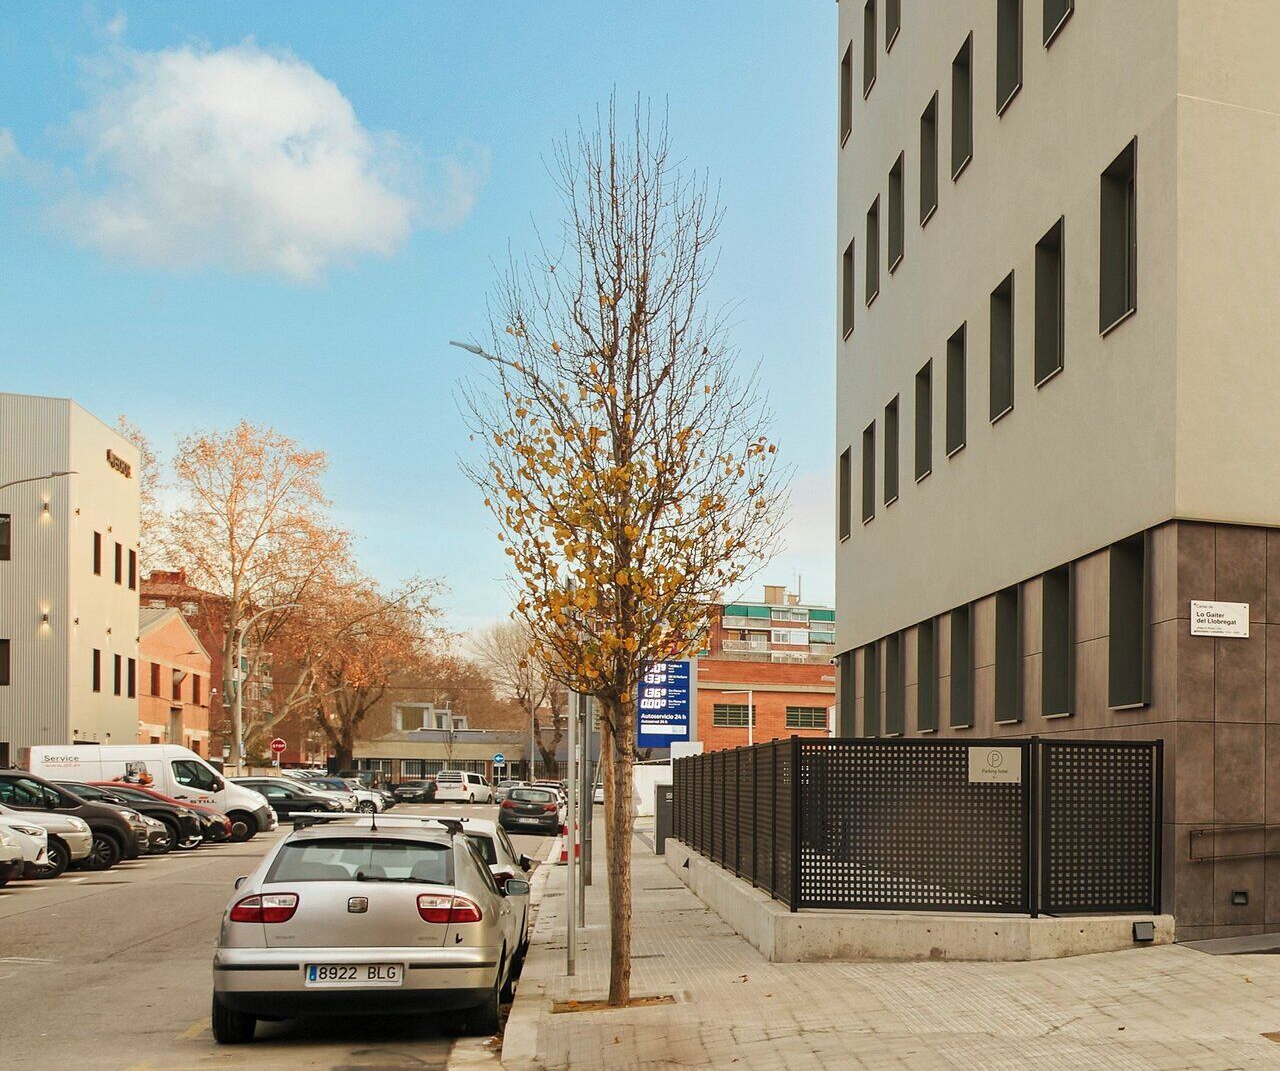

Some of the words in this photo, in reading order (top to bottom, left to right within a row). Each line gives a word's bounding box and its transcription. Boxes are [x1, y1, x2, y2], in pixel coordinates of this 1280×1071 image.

[1207, 618, 1237, 626] Llobregat
[44, 754, 79, 762] Service
[318, 966, 358, 980] 8922
[367, 966, 397, 980] BLG
